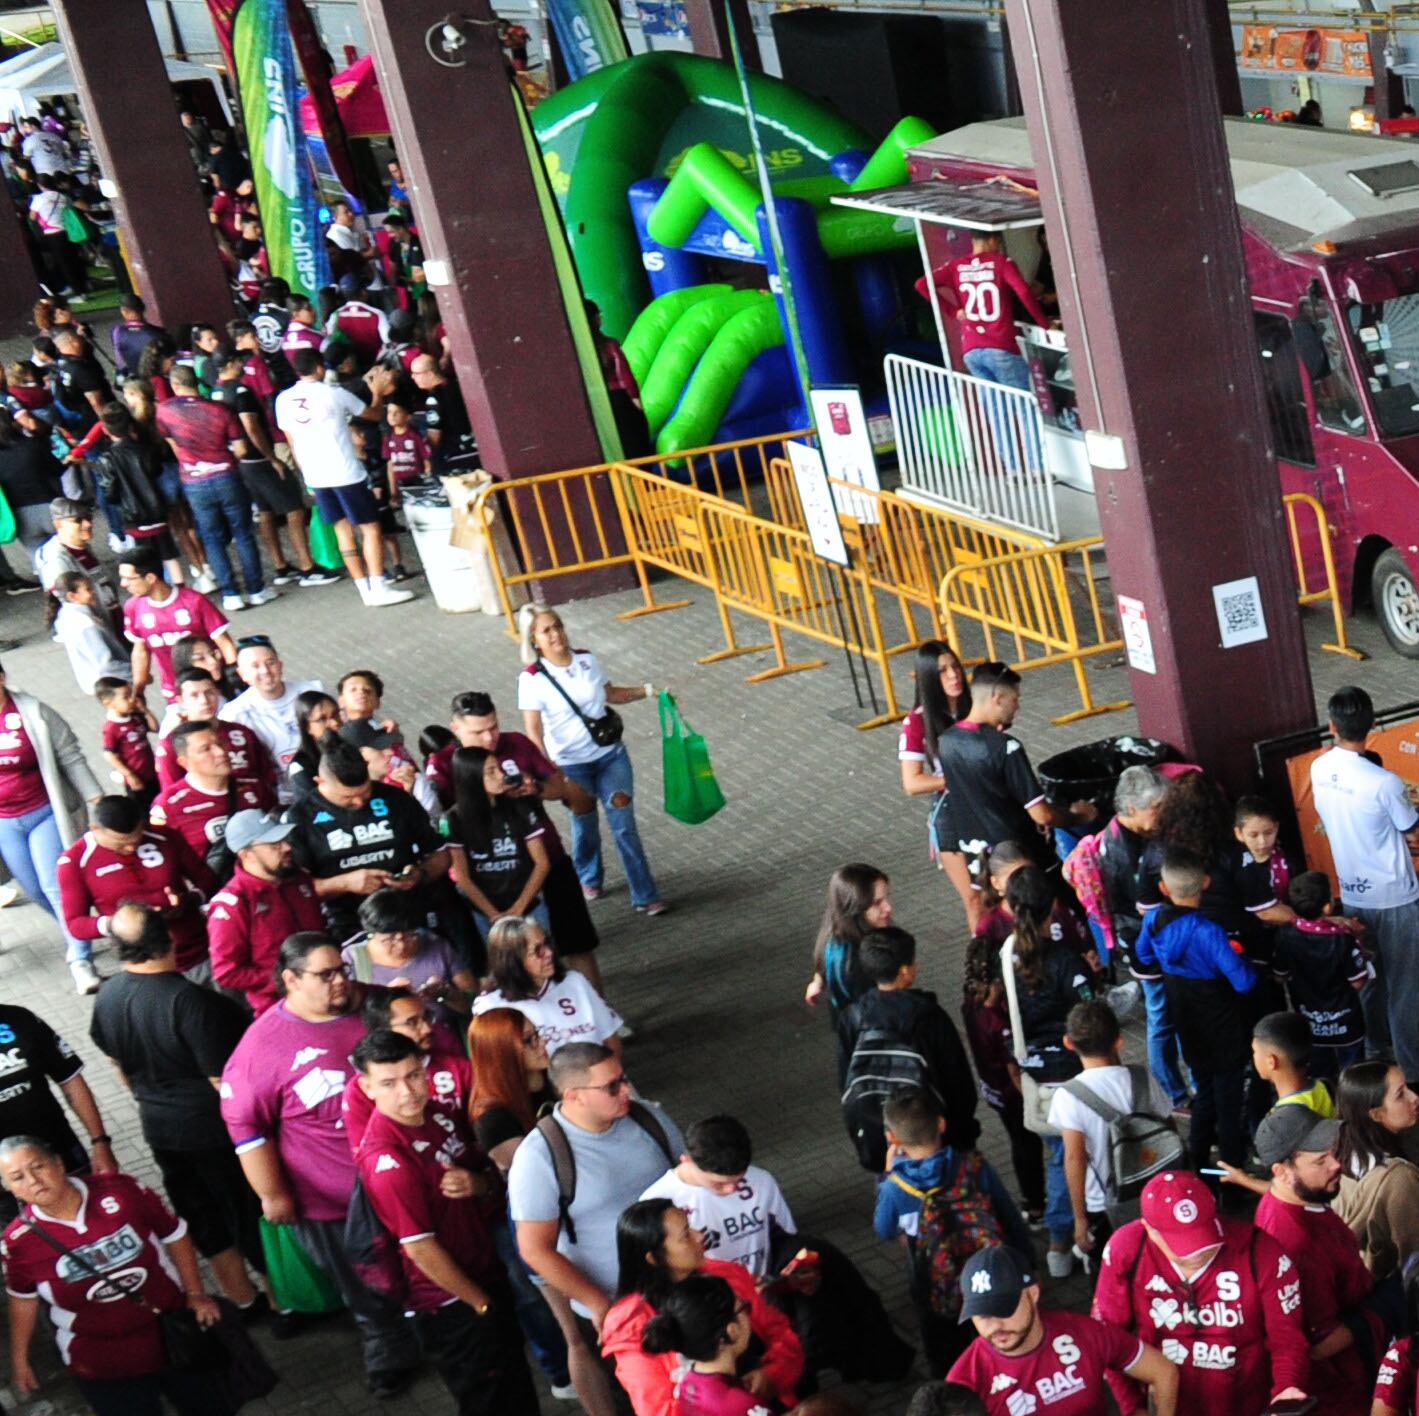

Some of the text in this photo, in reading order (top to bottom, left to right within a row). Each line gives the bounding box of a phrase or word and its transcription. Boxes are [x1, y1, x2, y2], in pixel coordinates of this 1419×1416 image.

[959, 281, 1001, 322] 20
[369, 797, 390, 817] S
[352, 820, 395, 843] BAC
[137, 843, 165, 868] S
[339, 849, 395, 870] LIBERTY
[558, 997, 577, 1017] S
[0, 1048, 28, 1071] AC
[433, 1070, 455, 1094] S
[735, 1177, 755, 1201] S
[100, 1196, 121, 1215] S
[1179, 1203, 1193, 1218] S
[723, 1206, 765, 1237] BAC
[1215, 1270, 1241, 1301] S
[1182, 1302, 1245, 1328] kölbi
[1052, 1334, 1082, 1366] S
[1192, 1342, 1237, 1365] BAC
[1034, 1363, 1085, 1401] BAC
